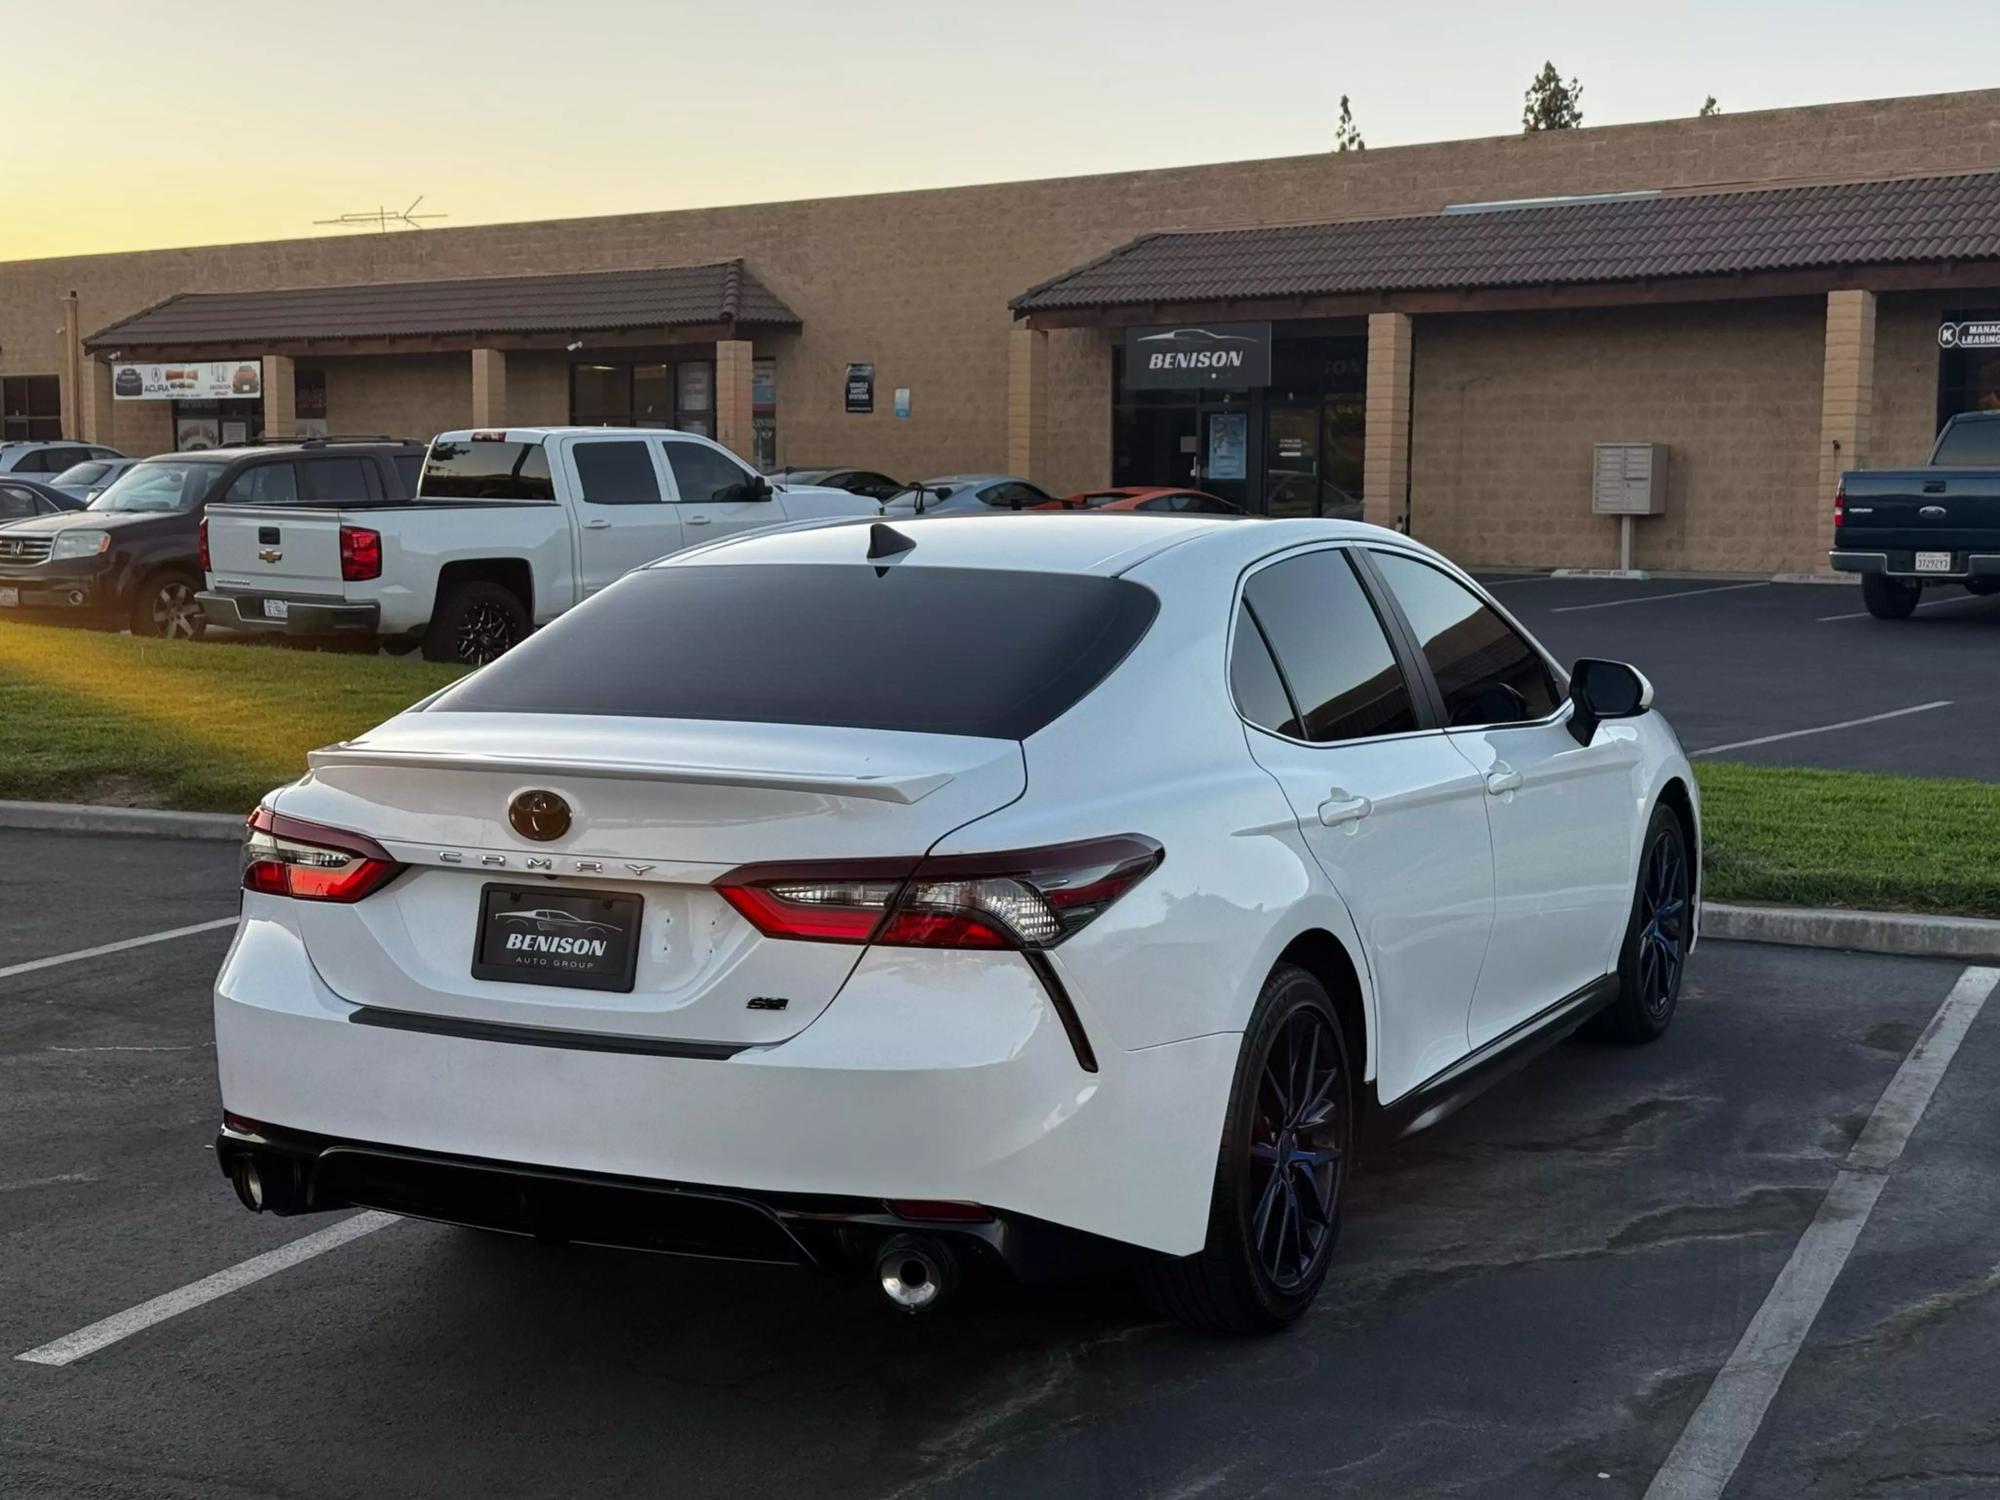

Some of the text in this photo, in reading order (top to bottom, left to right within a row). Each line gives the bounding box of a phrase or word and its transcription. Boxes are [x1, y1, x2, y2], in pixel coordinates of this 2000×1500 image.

[1149, 351, 1243, 369] BENISON
[439, 851, 657, 876] CAMRY
[506, 933, 607, 957] BENISON
[516, 956, 594, 969] AUTO GROUP
